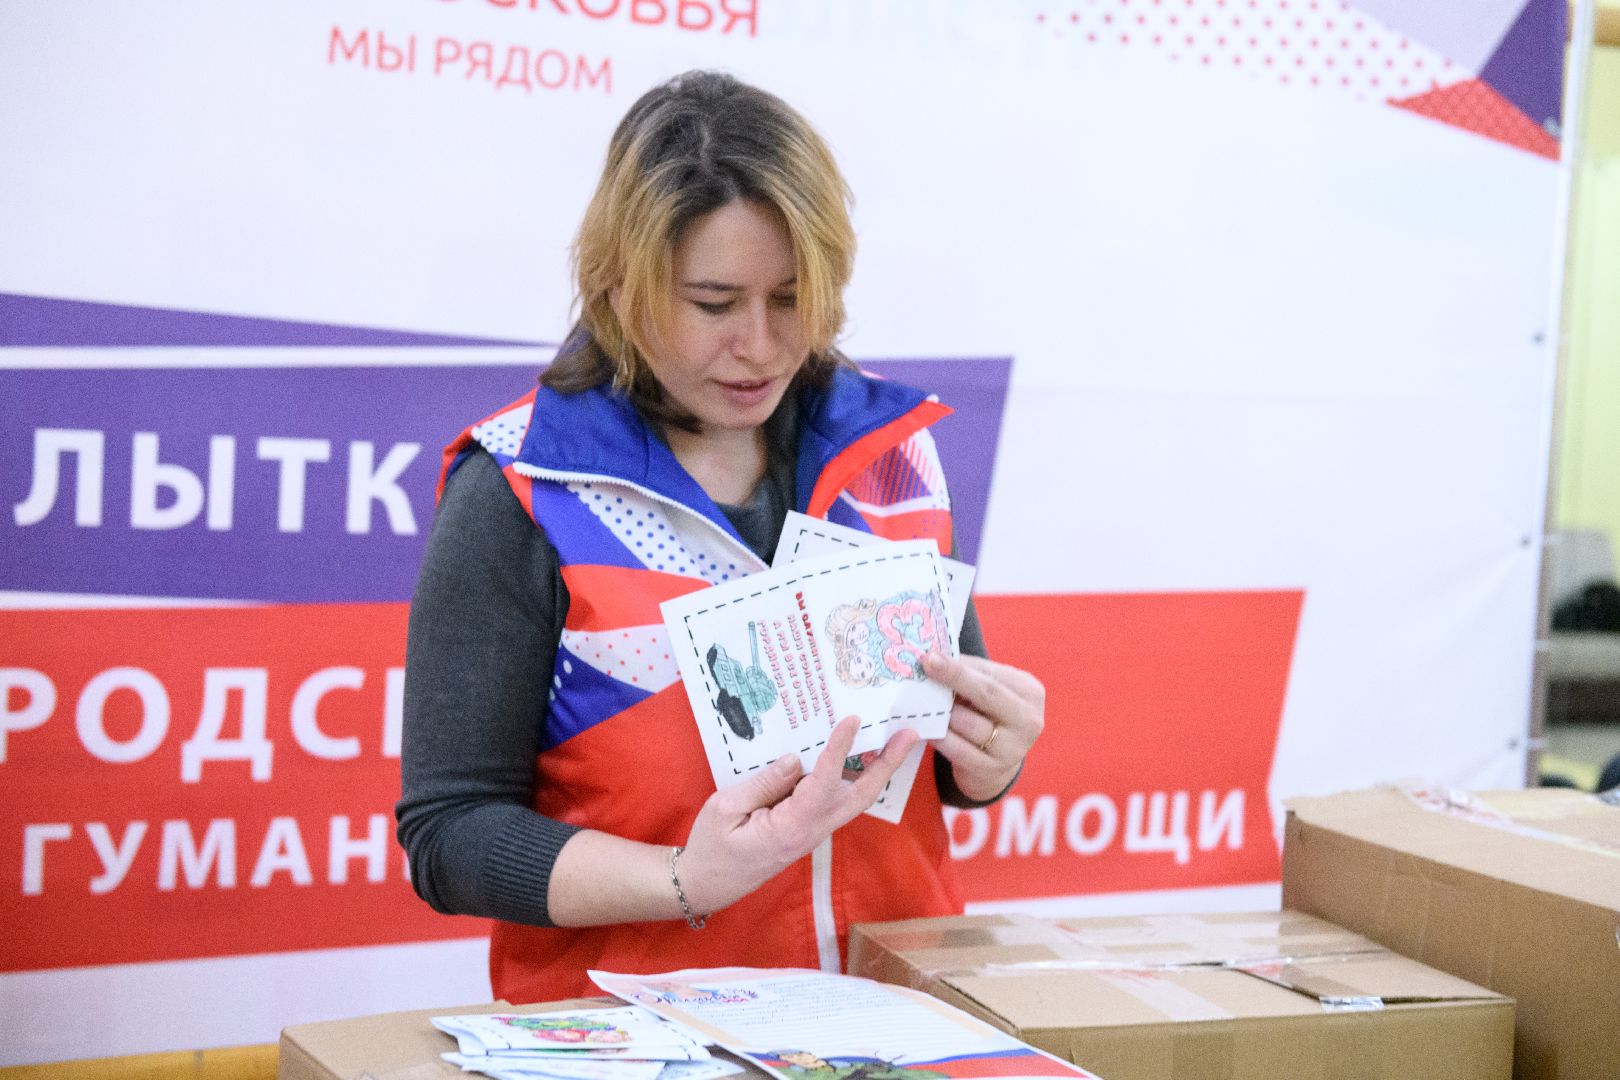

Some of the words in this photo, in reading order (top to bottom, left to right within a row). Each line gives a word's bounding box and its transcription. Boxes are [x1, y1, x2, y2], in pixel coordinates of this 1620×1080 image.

[328, 25, 416, 73] МЫ
[434, 36, 613, 94] РЯДОМ
[13, 428, 422, 536] ЛЫТК
[22, 814, 411, 896] ГУМАН
